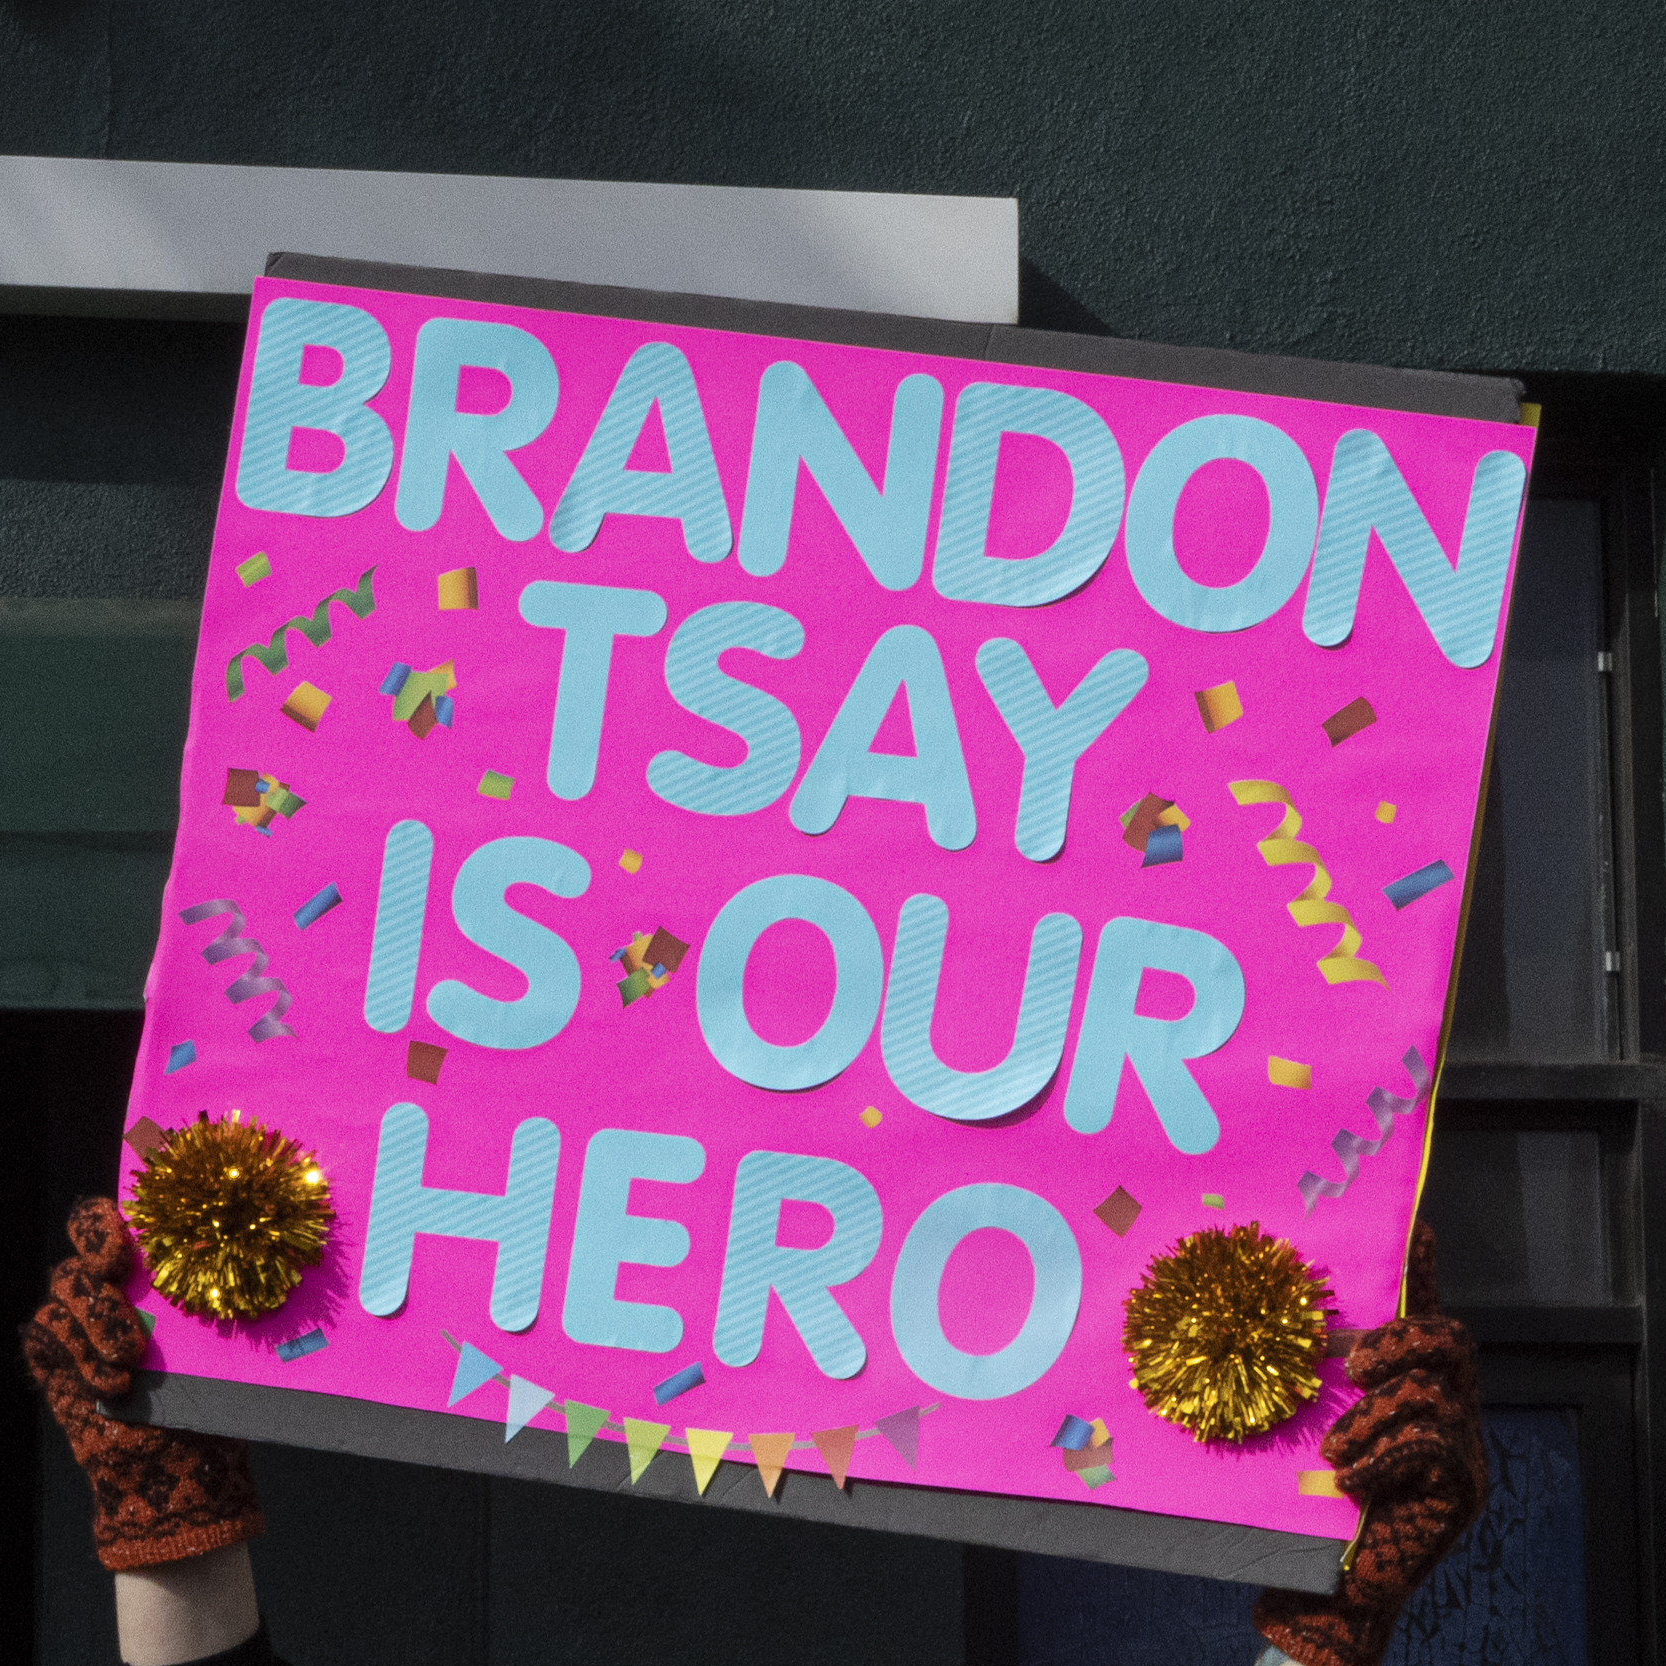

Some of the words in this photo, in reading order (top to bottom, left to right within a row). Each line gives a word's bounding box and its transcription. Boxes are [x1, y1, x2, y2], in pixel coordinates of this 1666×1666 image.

[234, 296, 1526, 669] BRANDON
[517, 579, 1149, 862] TSAY
[362, 818, 592, 1050] IS
[695, 873, 1246, 1155] OUR
[357, 1101, 1083, 1400] HERO
